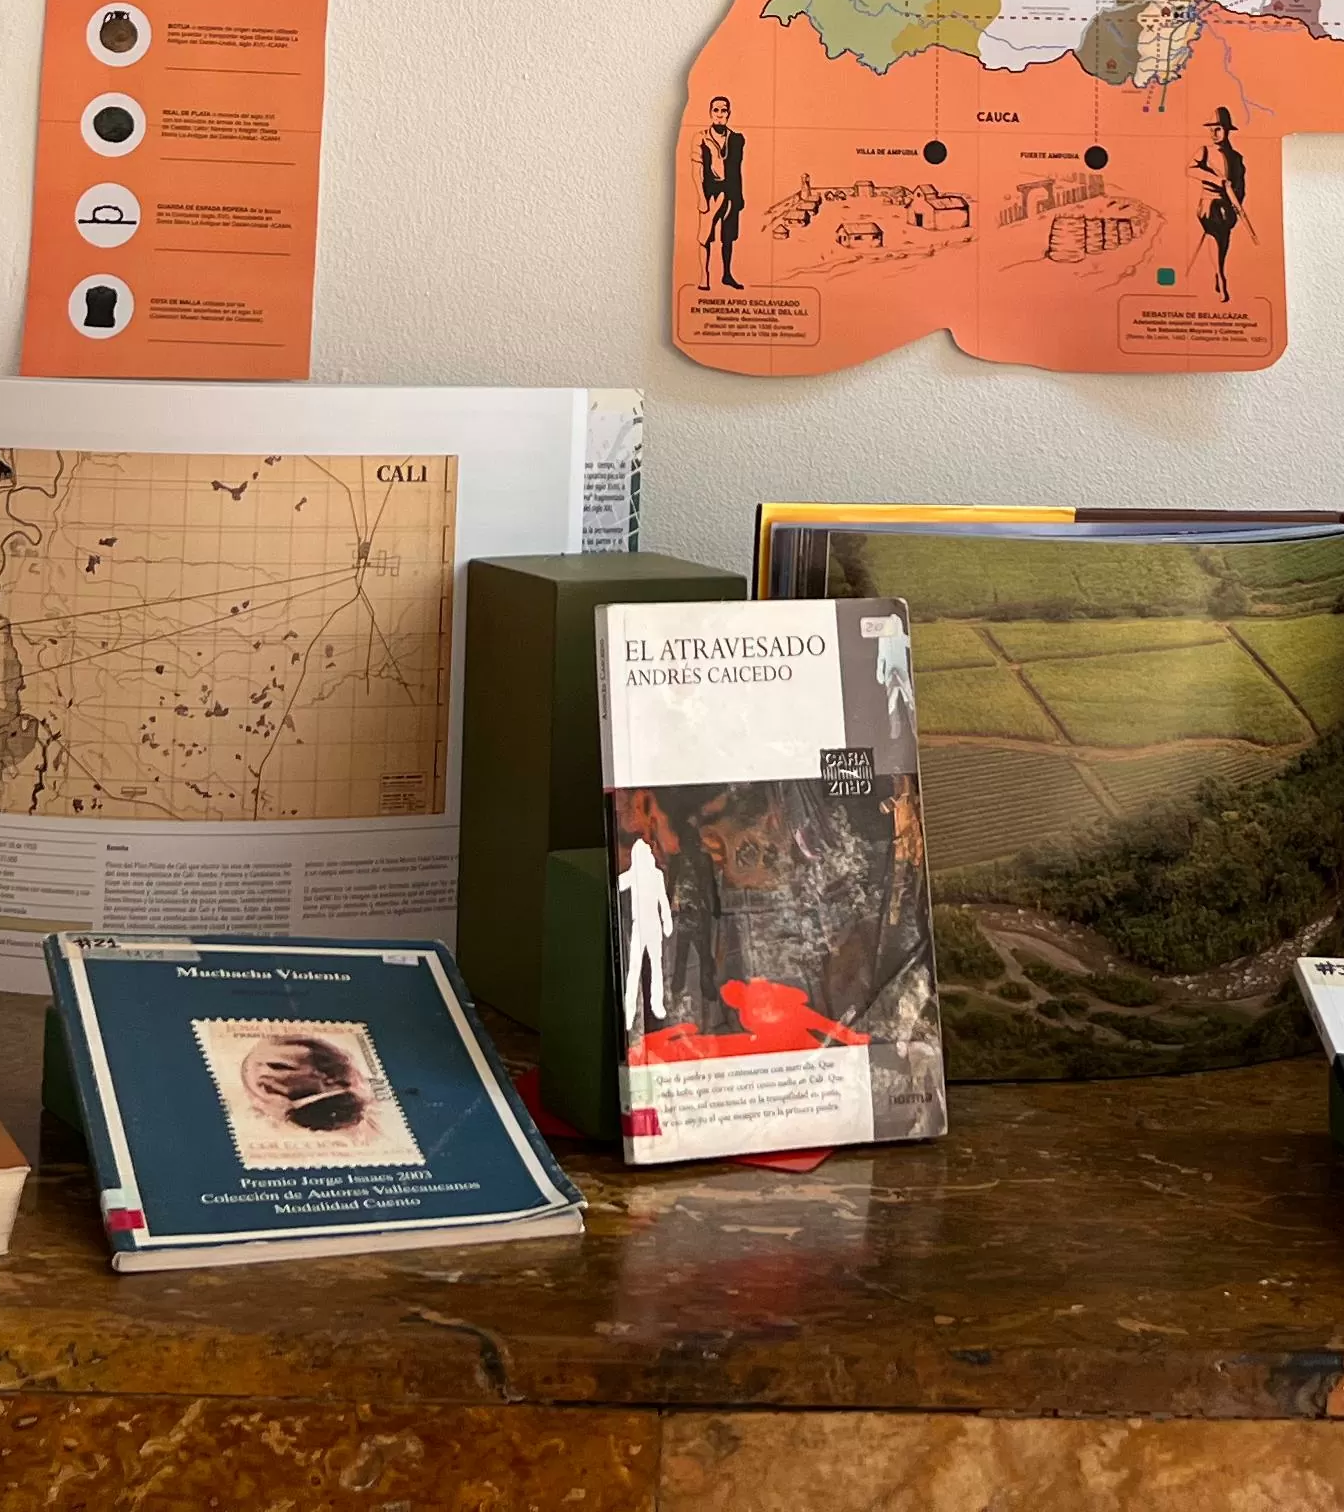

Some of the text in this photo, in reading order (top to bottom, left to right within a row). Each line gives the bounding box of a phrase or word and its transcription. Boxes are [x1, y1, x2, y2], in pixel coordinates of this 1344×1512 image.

[976, 111, 1020, 124] CAUCA
[377, 463, 427, 483] CALI
[625, 634, 826, 662] EL ATRAVESADO
[625, 661, 793, 687] ANDRÉS CAICEDO
[825, 751, 870, 767] CARA
[176, 966, 272, 981] Muchacha
[239, 1169, 433, 1189] Premio Jorge Isaacs 2003
[200, 1180, 481, 1205] Colección de Autores Vallecaucanos
[273, 1196, 422, 1215] Modalidad Cuento
